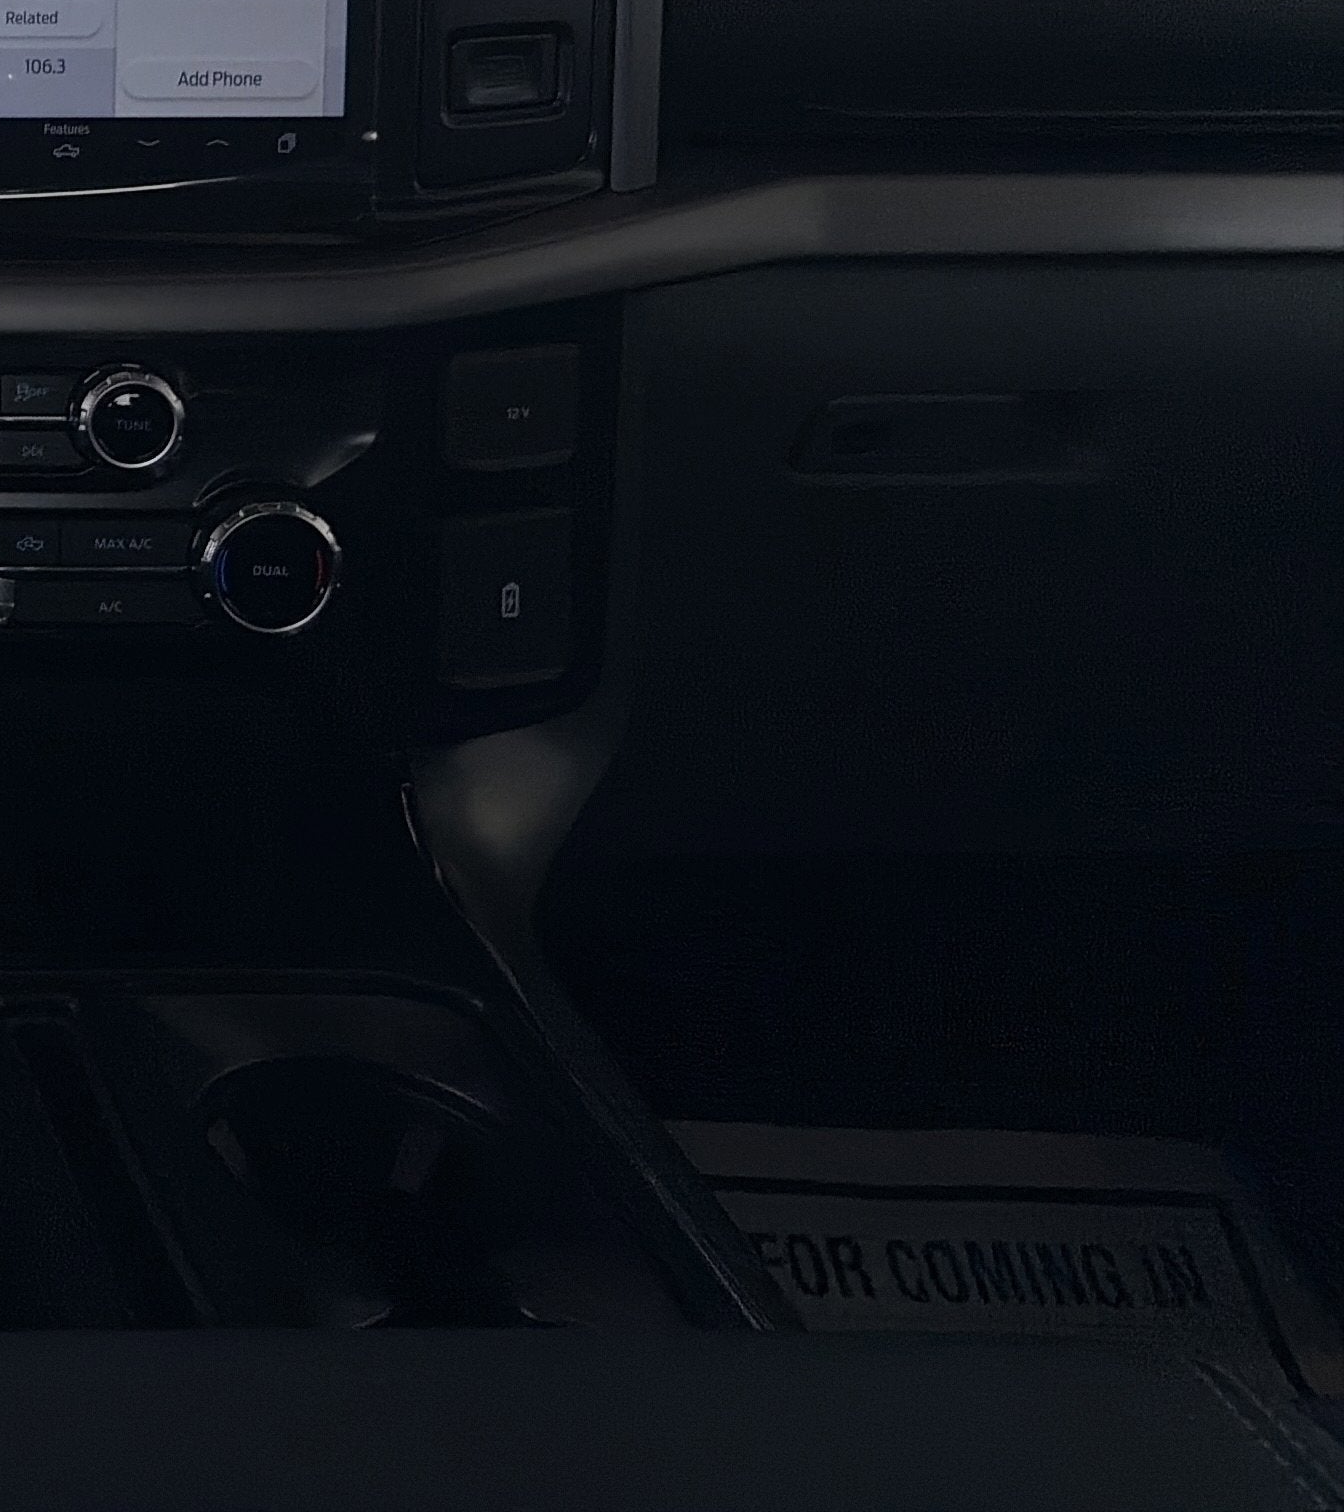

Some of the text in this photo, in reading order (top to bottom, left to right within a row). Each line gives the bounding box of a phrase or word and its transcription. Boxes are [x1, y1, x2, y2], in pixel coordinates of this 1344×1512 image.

[6, 11, 59, 26] Related
[24, 59, 66, 75] 106.3
[178, 71, 263, 87] Add Phone
[43, 122, 90, 136] Features
[94, 536, 153, 550] MAX A/C
[252, 564, 290, 577] DUAL
[98, 600, 123, 614] A/C
[748, 1231, 1212, 1309] FOR COMING IN
